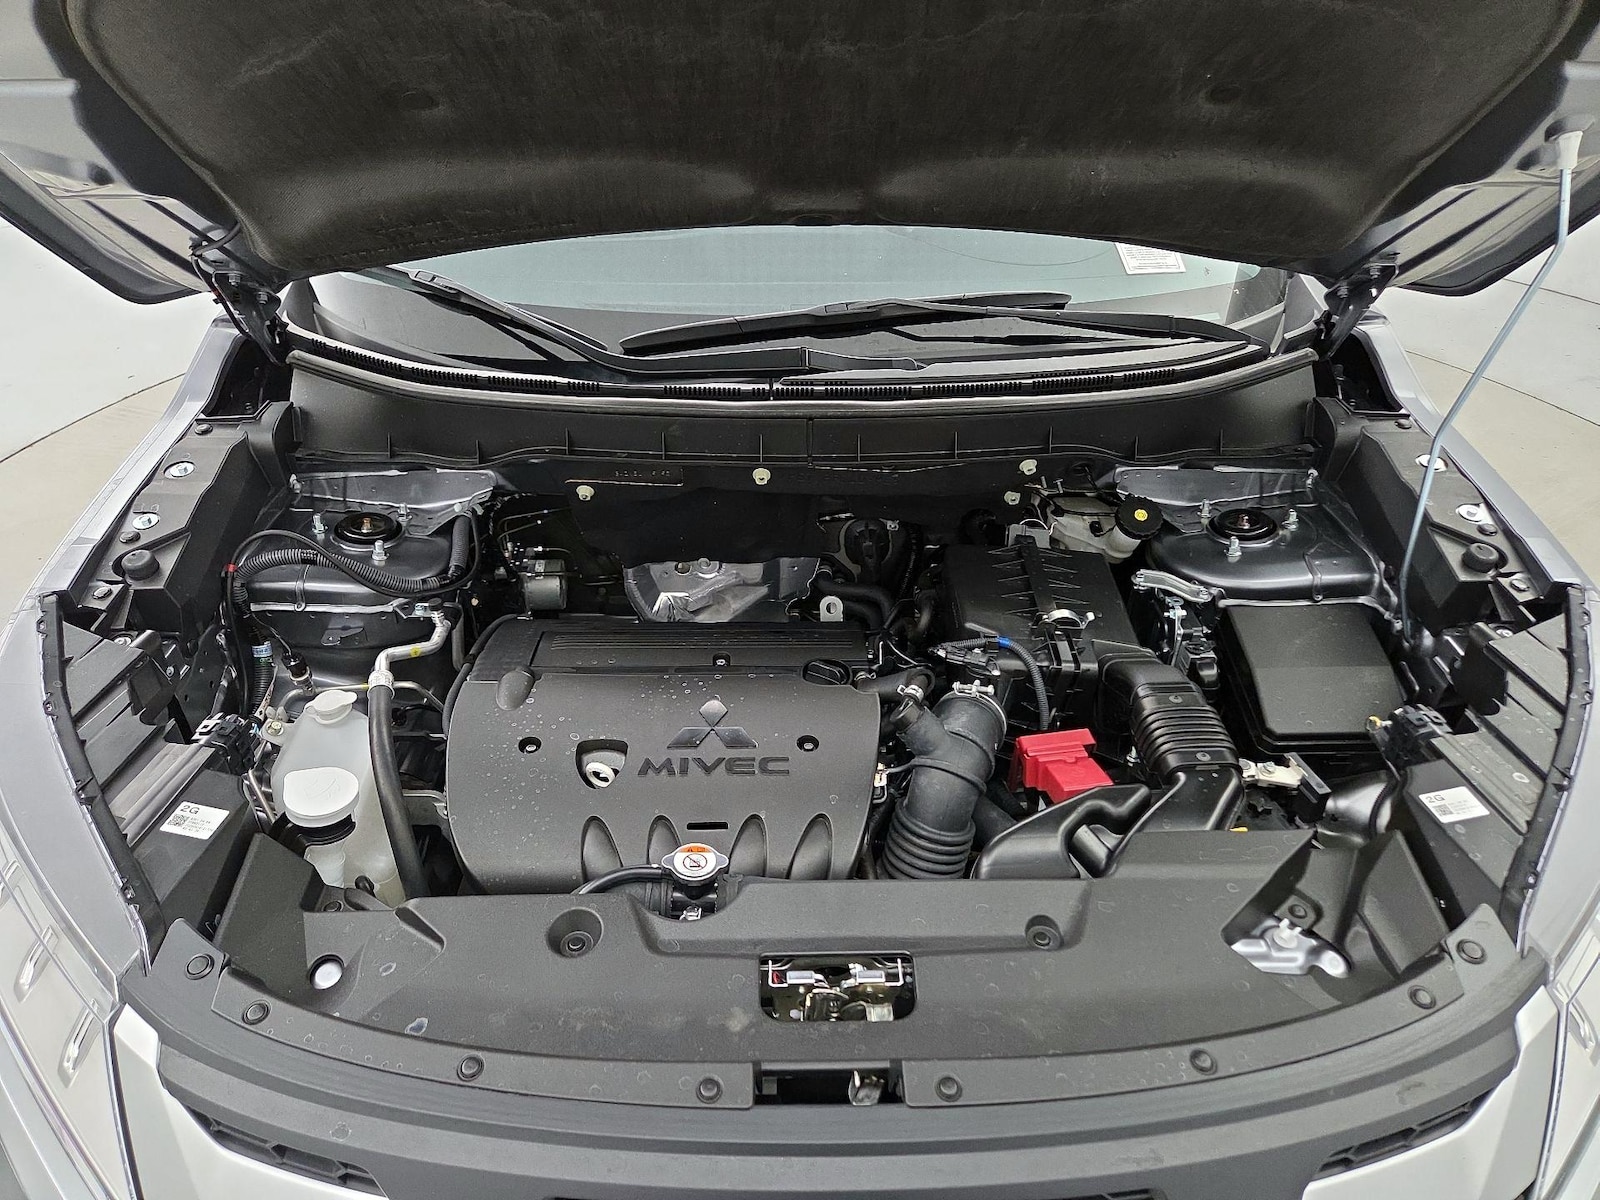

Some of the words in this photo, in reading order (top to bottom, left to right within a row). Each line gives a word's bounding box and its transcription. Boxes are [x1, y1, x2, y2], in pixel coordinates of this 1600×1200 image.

[637, 757, 790, 776] MIVEC
[1425, 794, 1446, 803] 2G
[180, 804, 200, 815] 2G
